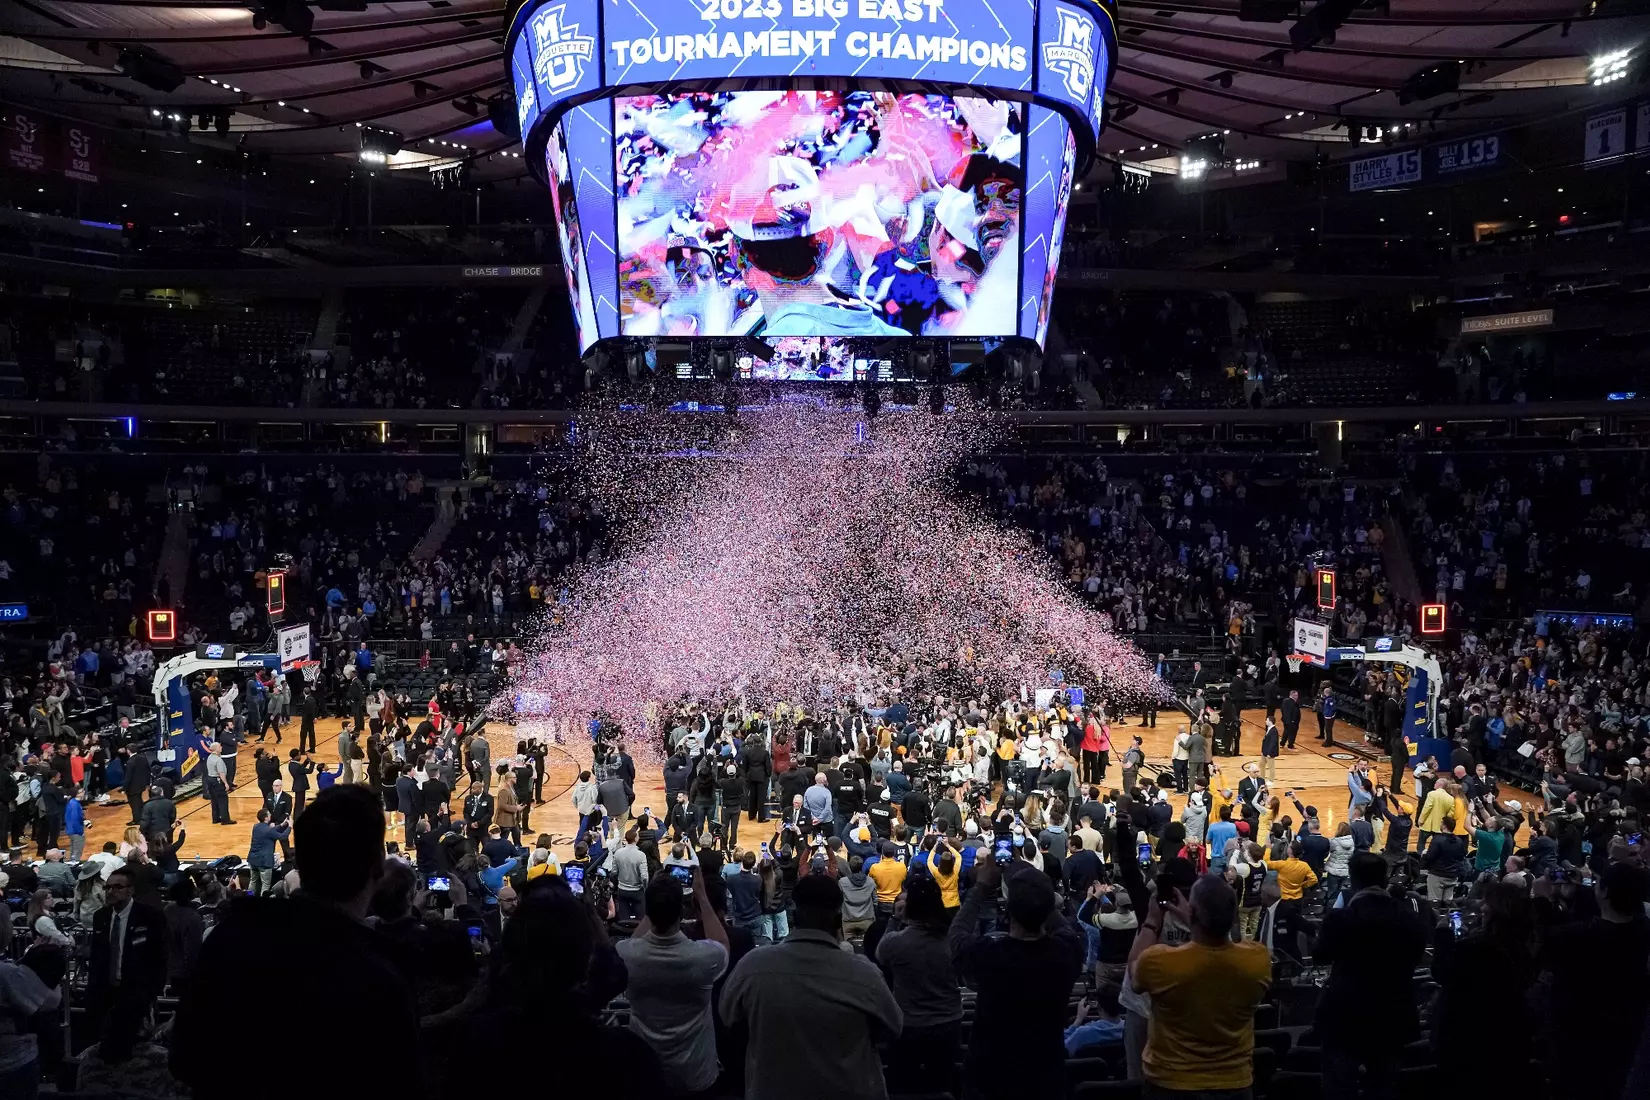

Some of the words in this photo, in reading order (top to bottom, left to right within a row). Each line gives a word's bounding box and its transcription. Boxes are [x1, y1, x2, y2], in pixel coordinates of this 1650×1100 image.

[701, 0, 782, 20] 2023
[793, 0, 849, 18] BIG
[858, 0, 943, 23] EAST
[612, 31, 836, 66] TOURNAMENT
[845, 31, 1027, 72] CHAMPIONS
[1599, 129, 1610, 154] 1
[1438, 144, 1458, 157] BILLY
[1460, 136, 1499, 165] 133
[1355, 157, 1388, 173] HARRY
[1396, 153, 1418, 176] 15
[1439, 156, 1457, 169] JOEL
[1353, 168, 1392, 183] STYLES
[464, 268, 499, 276] CHASE
[510, 267, 540, 276] BRIDGE
[1495, 316, 1519, 326] SUITE
[1522, 314, 1549, 324] LEVEL
